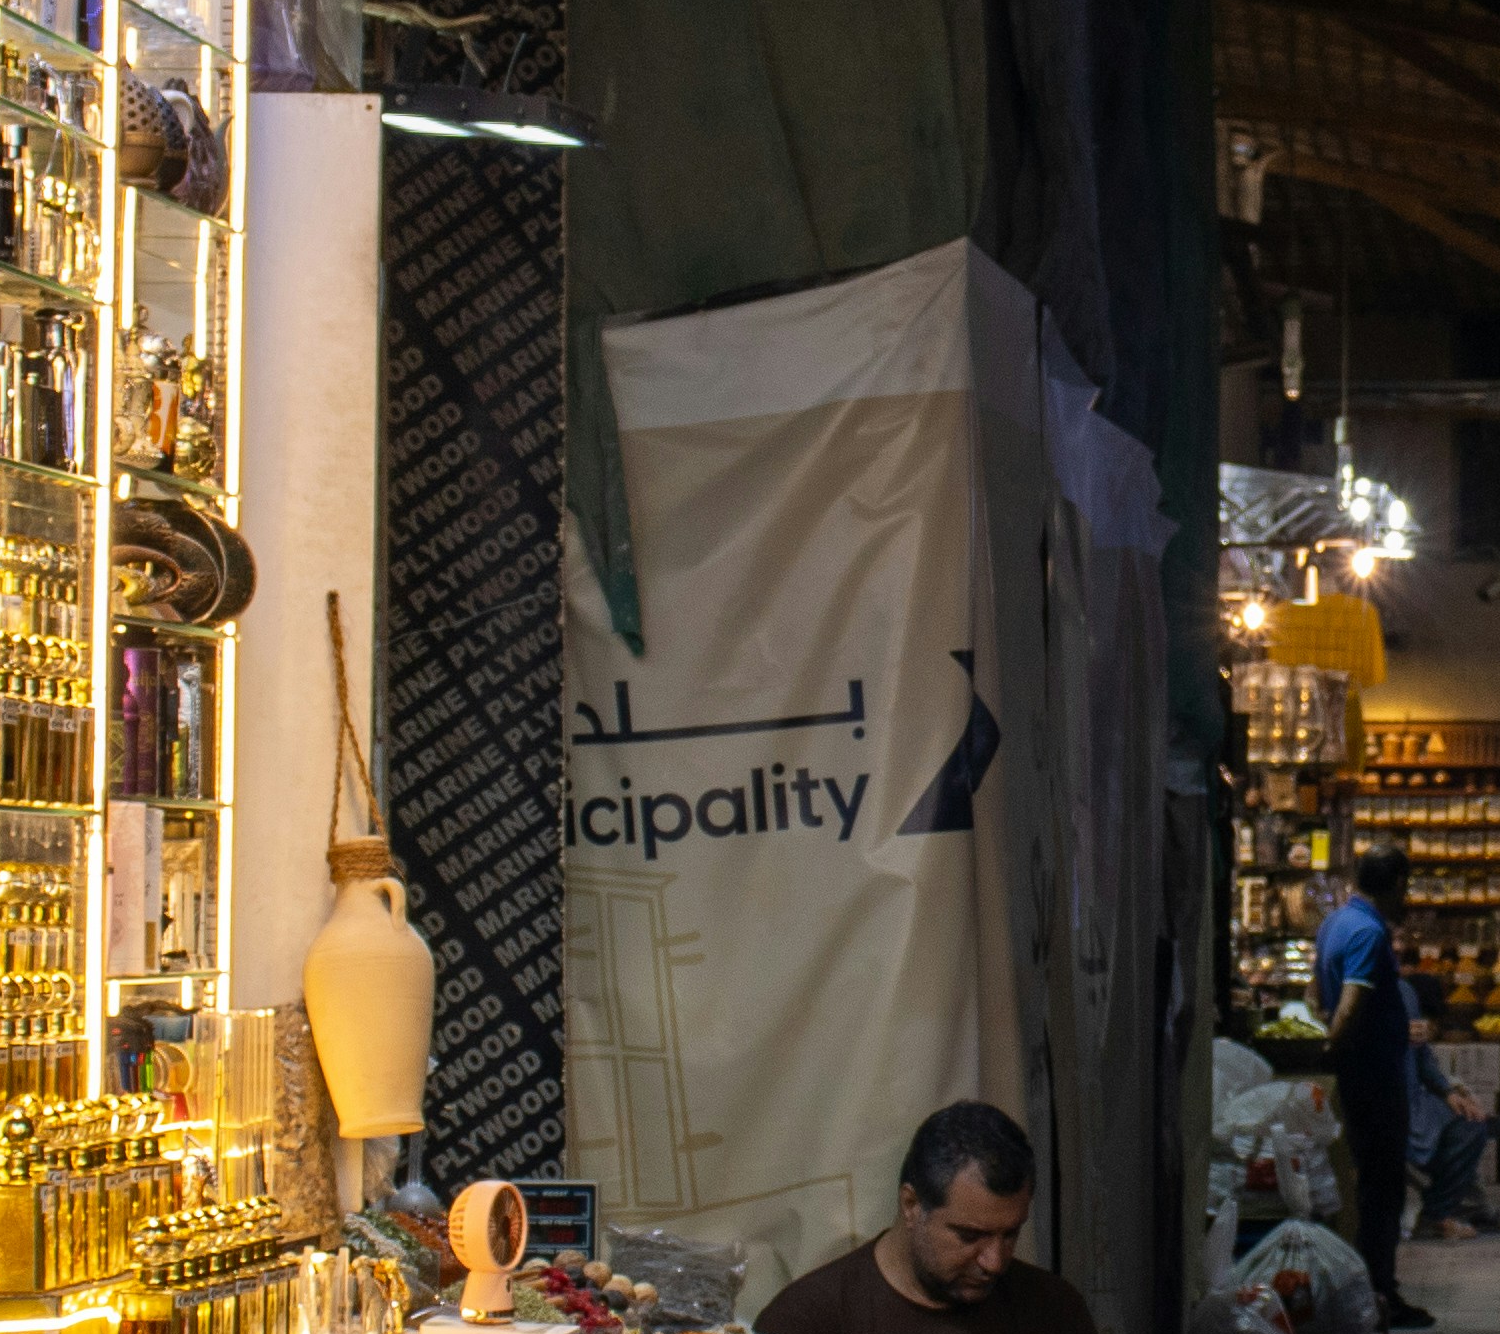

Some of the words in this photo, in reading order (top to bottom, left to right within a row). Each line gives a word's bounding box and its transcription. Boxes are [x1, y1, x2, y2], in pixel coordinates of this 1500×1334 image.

[397, 208, 504, 292] MARINE
[415, 234, 522, 320] MARINE
[434, 261, 541, 348] MARINE
[453, 290, 560, 375] MARINE
[472, 322, 563, 404] MARIN
[490, 369, 563, 432] MARI
[388, 458, 500, 547] LYWOOD
[389, 429, 481, 507] YWOOD
[390, 486, 520, 587] PLYWOOD
[408, 512, 539, 615] PLYWOOD
[427, 540, 558, 643] PLYWOOD
[445, 579, 560, 670] PLYWOO
[465, 621, 561, 699] PLYWO
[389, 686, 468, 759] ARINE
[484, 658, 561, 725] PLYW
[571, 679, 866, 746] بلد
[397, 742, 506, 829] MARINE
[415, 769, 526, 857] MARINE
[564, 762, 870, 861] icipality
[436, 797, 545, 885] MARINE
[454, 827, 562, 913] MARINE
[473, 866, 563, 941] MARIN
[492, 904, 563, 968] MARI
[426, 1021, 522, 1102] YWOOD
[429, 1049, 541, 1142] LYWOOD
[430, 1077, 560, 1180] PLYWOOD
